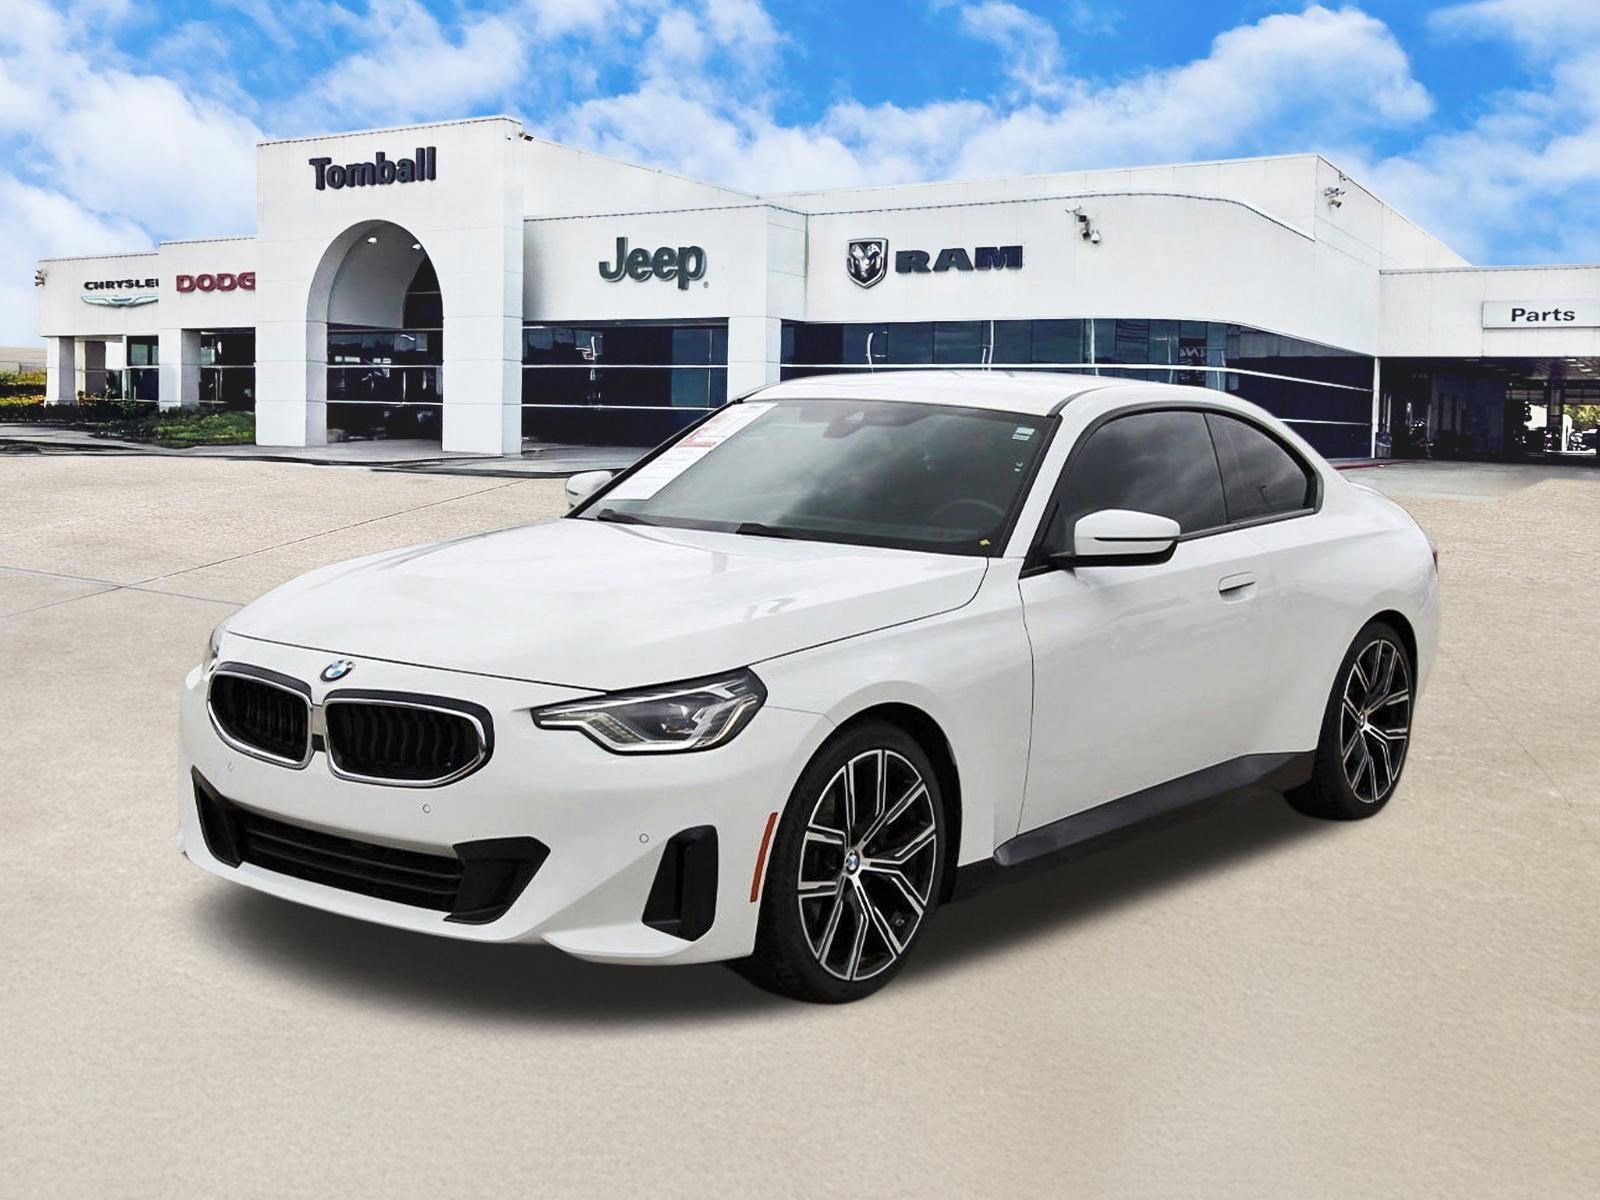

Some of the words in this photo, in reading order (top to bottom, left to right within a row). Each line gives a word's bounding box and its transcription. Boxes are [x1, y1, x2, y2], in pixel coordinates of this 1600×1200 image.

[308, 146, 437, 190] Tomball
[599, 236, 707, 291] Jeep
[895, 245, 1023, 273] RAM
[84, 278, 159, 290] CHRYSLE
[1511, 308, 1576, 322] Parts
